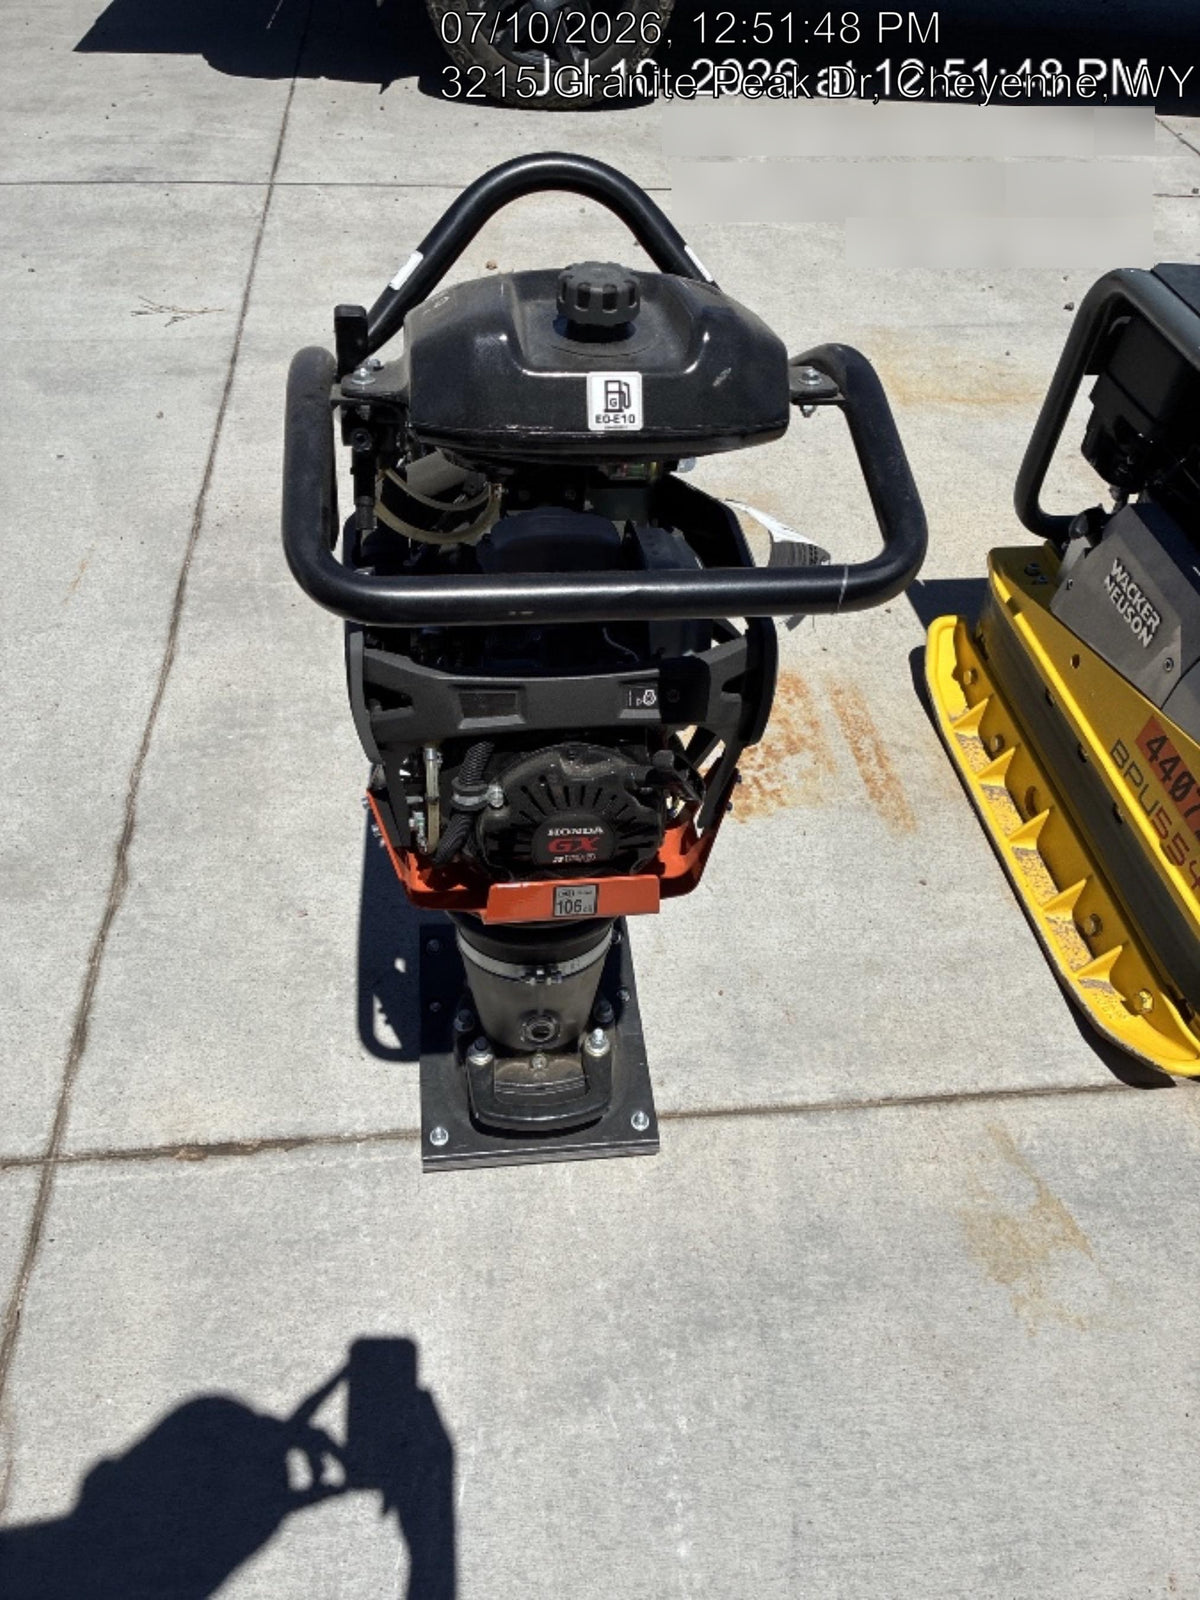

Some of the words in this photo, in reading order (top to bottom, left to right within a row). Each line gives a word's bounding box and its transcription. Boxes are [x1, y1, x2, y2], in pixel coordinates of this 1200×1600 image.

[1110, 558, 1161, 633] WACKER
[1103, 575, 1154, 648] NEUSON
[547, 826, 604, 837] HONDA
[547, 836, 600, 854] GX
[555, 898, 582, 914] 106
